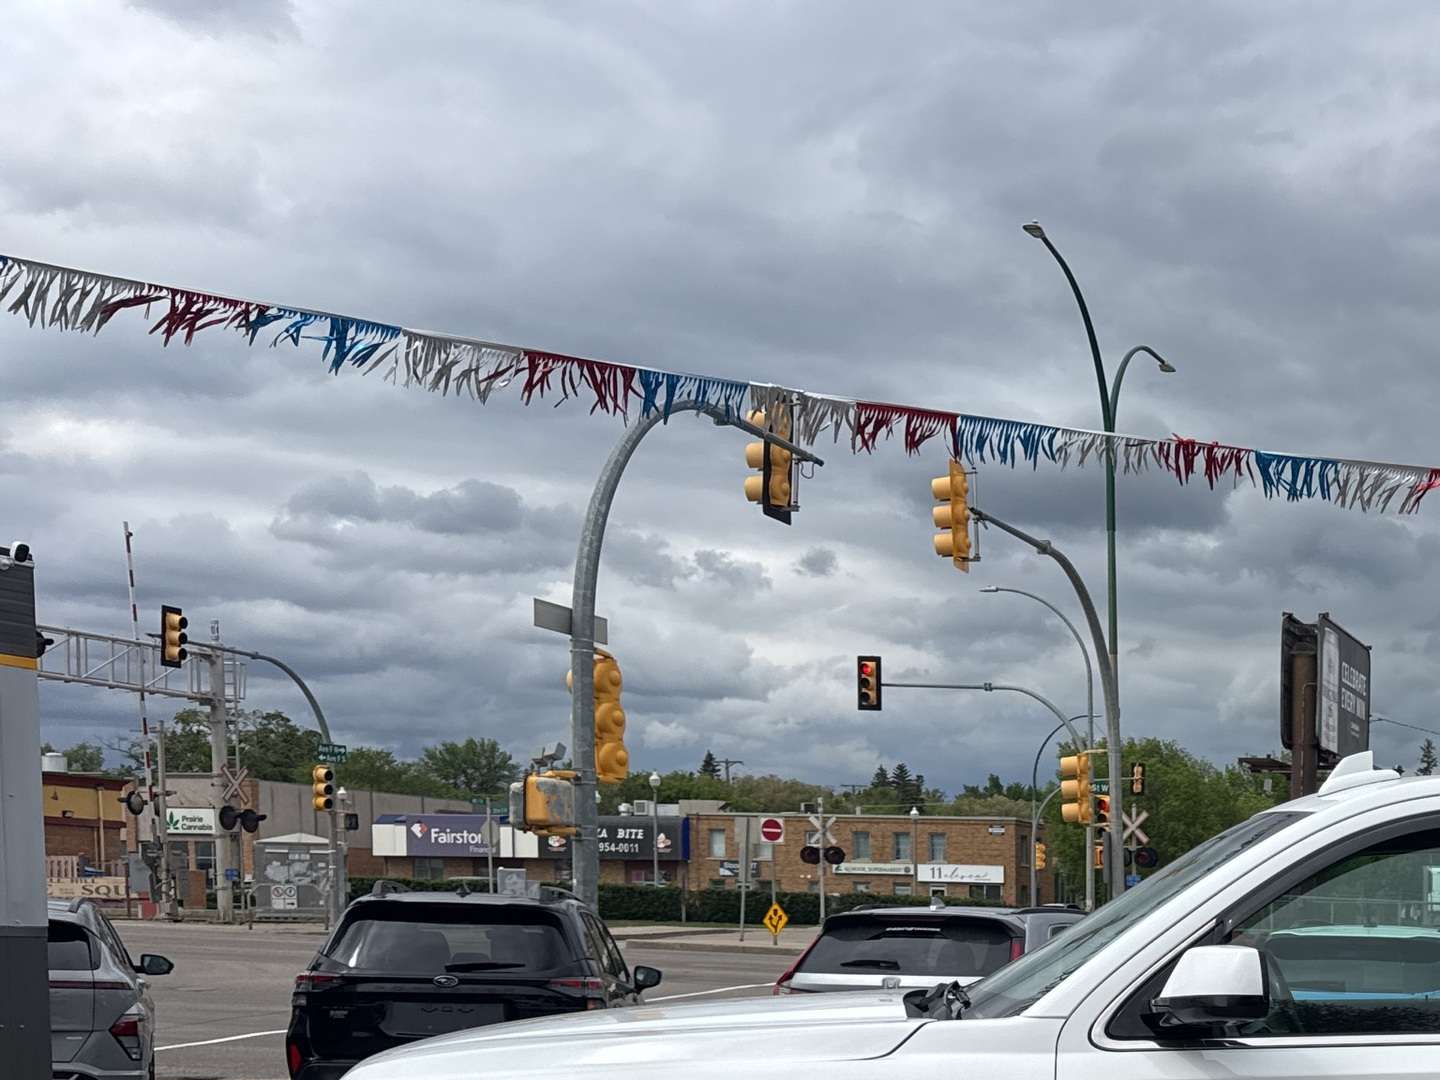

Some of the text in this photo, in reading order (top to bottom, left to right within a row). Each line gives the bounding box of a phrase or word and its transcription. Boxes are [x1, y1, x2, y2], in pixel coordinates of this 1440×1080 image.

[1341, 661, 1367, 697] CELEBRATE
[181, 823, 213, 831] Cannabis
[616, 828, 645, 839] BITE
